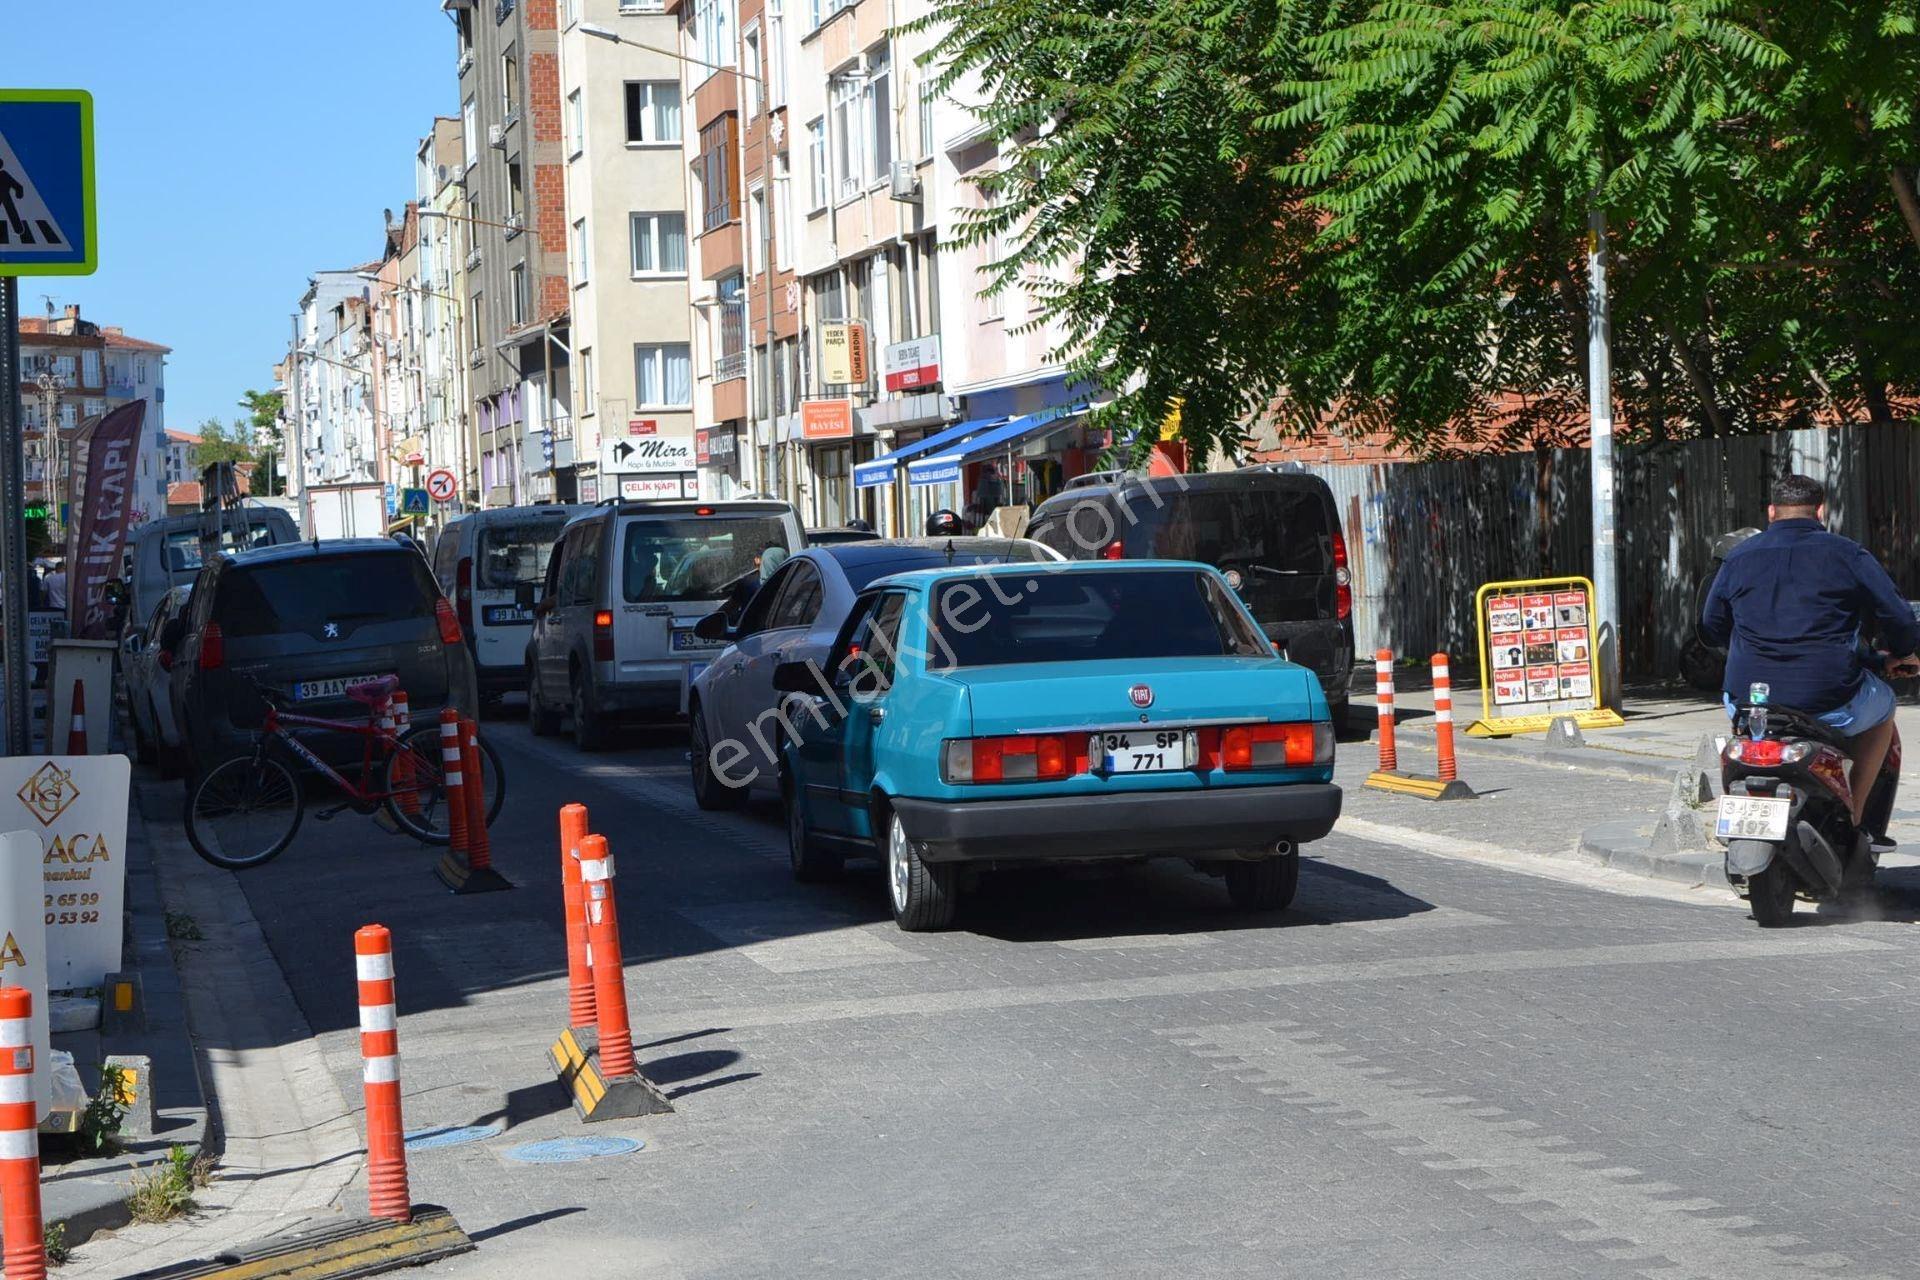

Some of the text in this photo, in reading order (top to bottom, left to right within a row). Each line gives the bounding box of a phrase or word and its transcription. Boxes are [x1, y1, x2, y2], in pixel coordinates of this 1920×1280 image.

[639, 440, 688, 458] Mira
[624, 481, 651, 492] ÇELİK
[654, 481, 676, 491] KAPI
[680, 633, 694, 645] 53
[301, 681, 319, 697] 39
[323, 679, 347, 695] AAY
[1134, 688, 1149, 702] FIAT
[1107, 733, 1180, 751] 34 SP
[1132, 753, 1164, 770] 771
[42, 833, 110, 863] ACA
[57, 893, 77, 906] 65
[79, 892, 99, 906] 99
[58, 911, 78, 924] 53
[79, 910, 99, 924] 92
